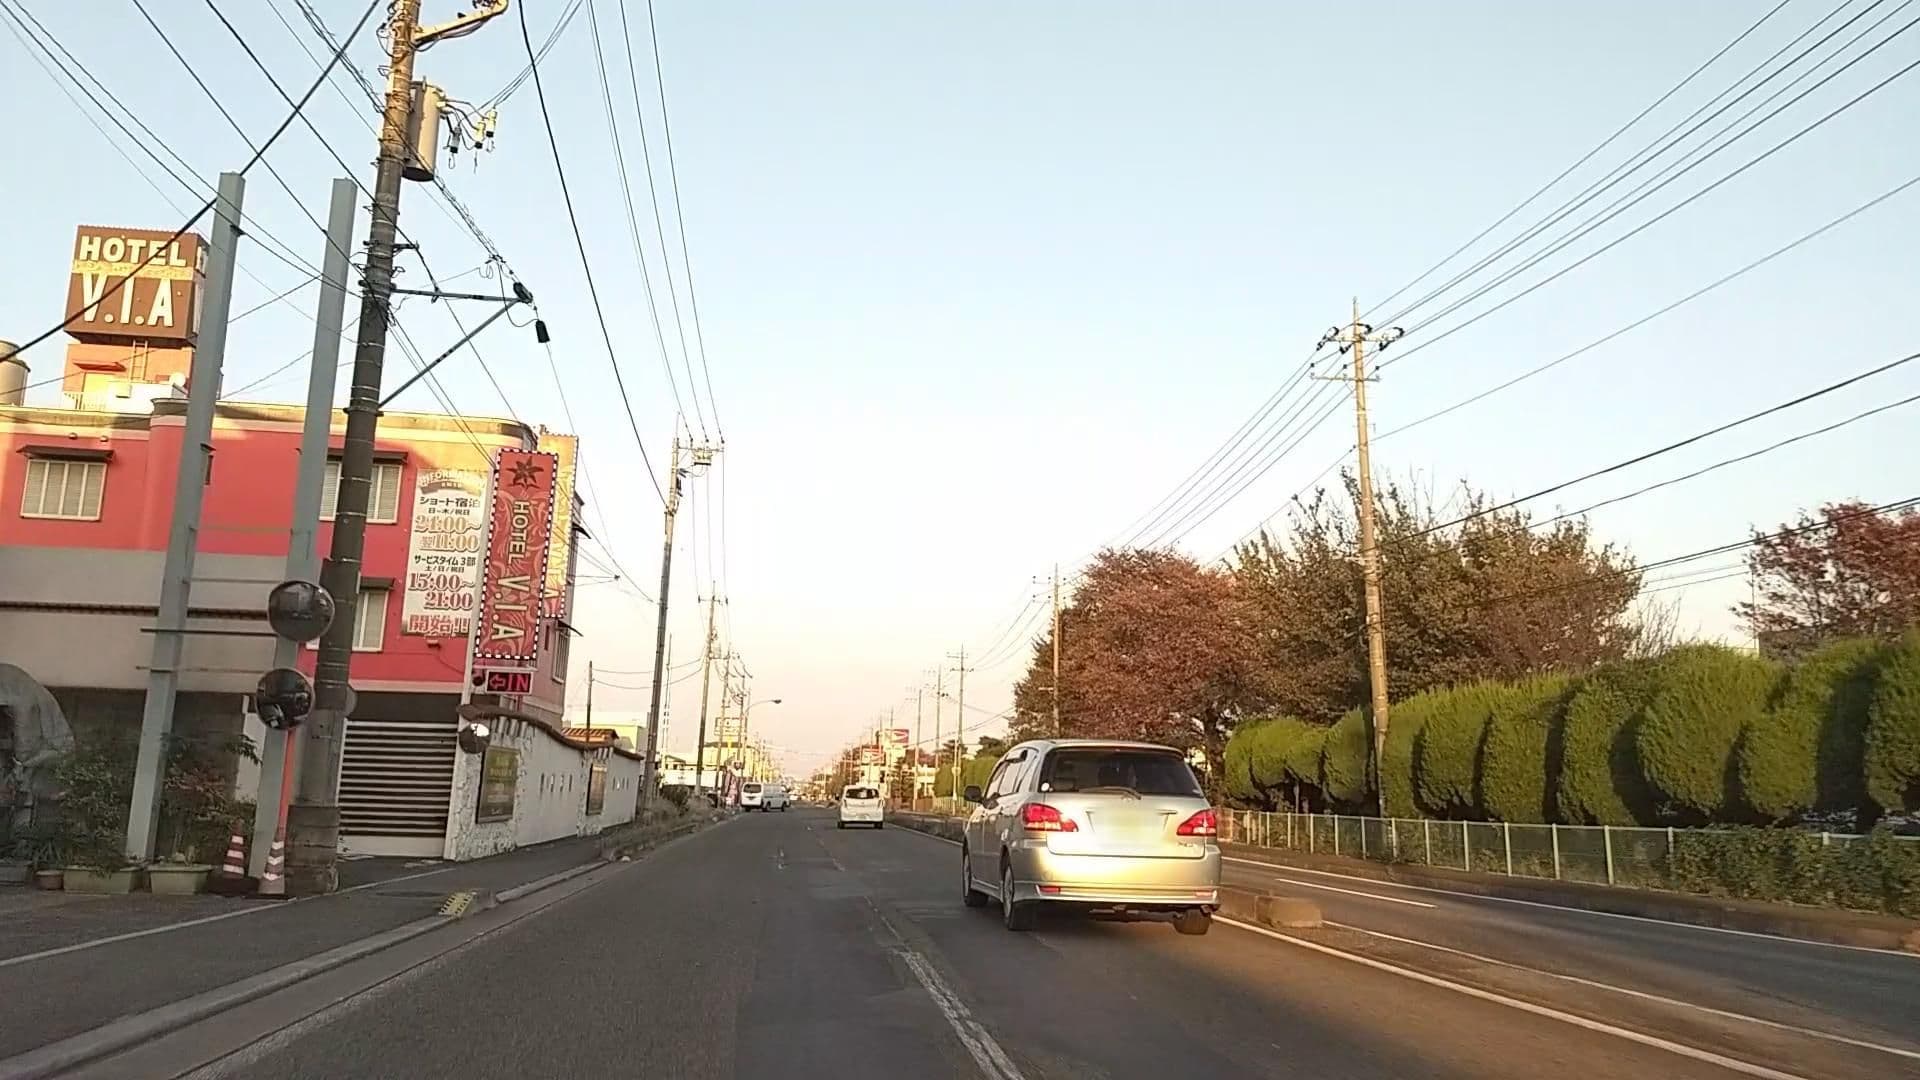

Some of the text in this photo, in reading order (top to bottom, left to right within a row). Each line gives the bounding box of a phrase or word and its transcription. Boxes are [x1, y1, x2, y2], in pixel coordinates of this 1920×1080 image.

[79, 235, 187, 267] HOTEL
[82, 273, 174, 327] V.I.A
[419, 496, 481, 508] ショート宿泊
[490, 500, 532, 641] HOTEL V.I.A
[424, 592, 474, 611] 21:00
[508, 674, 530, 692] IN
